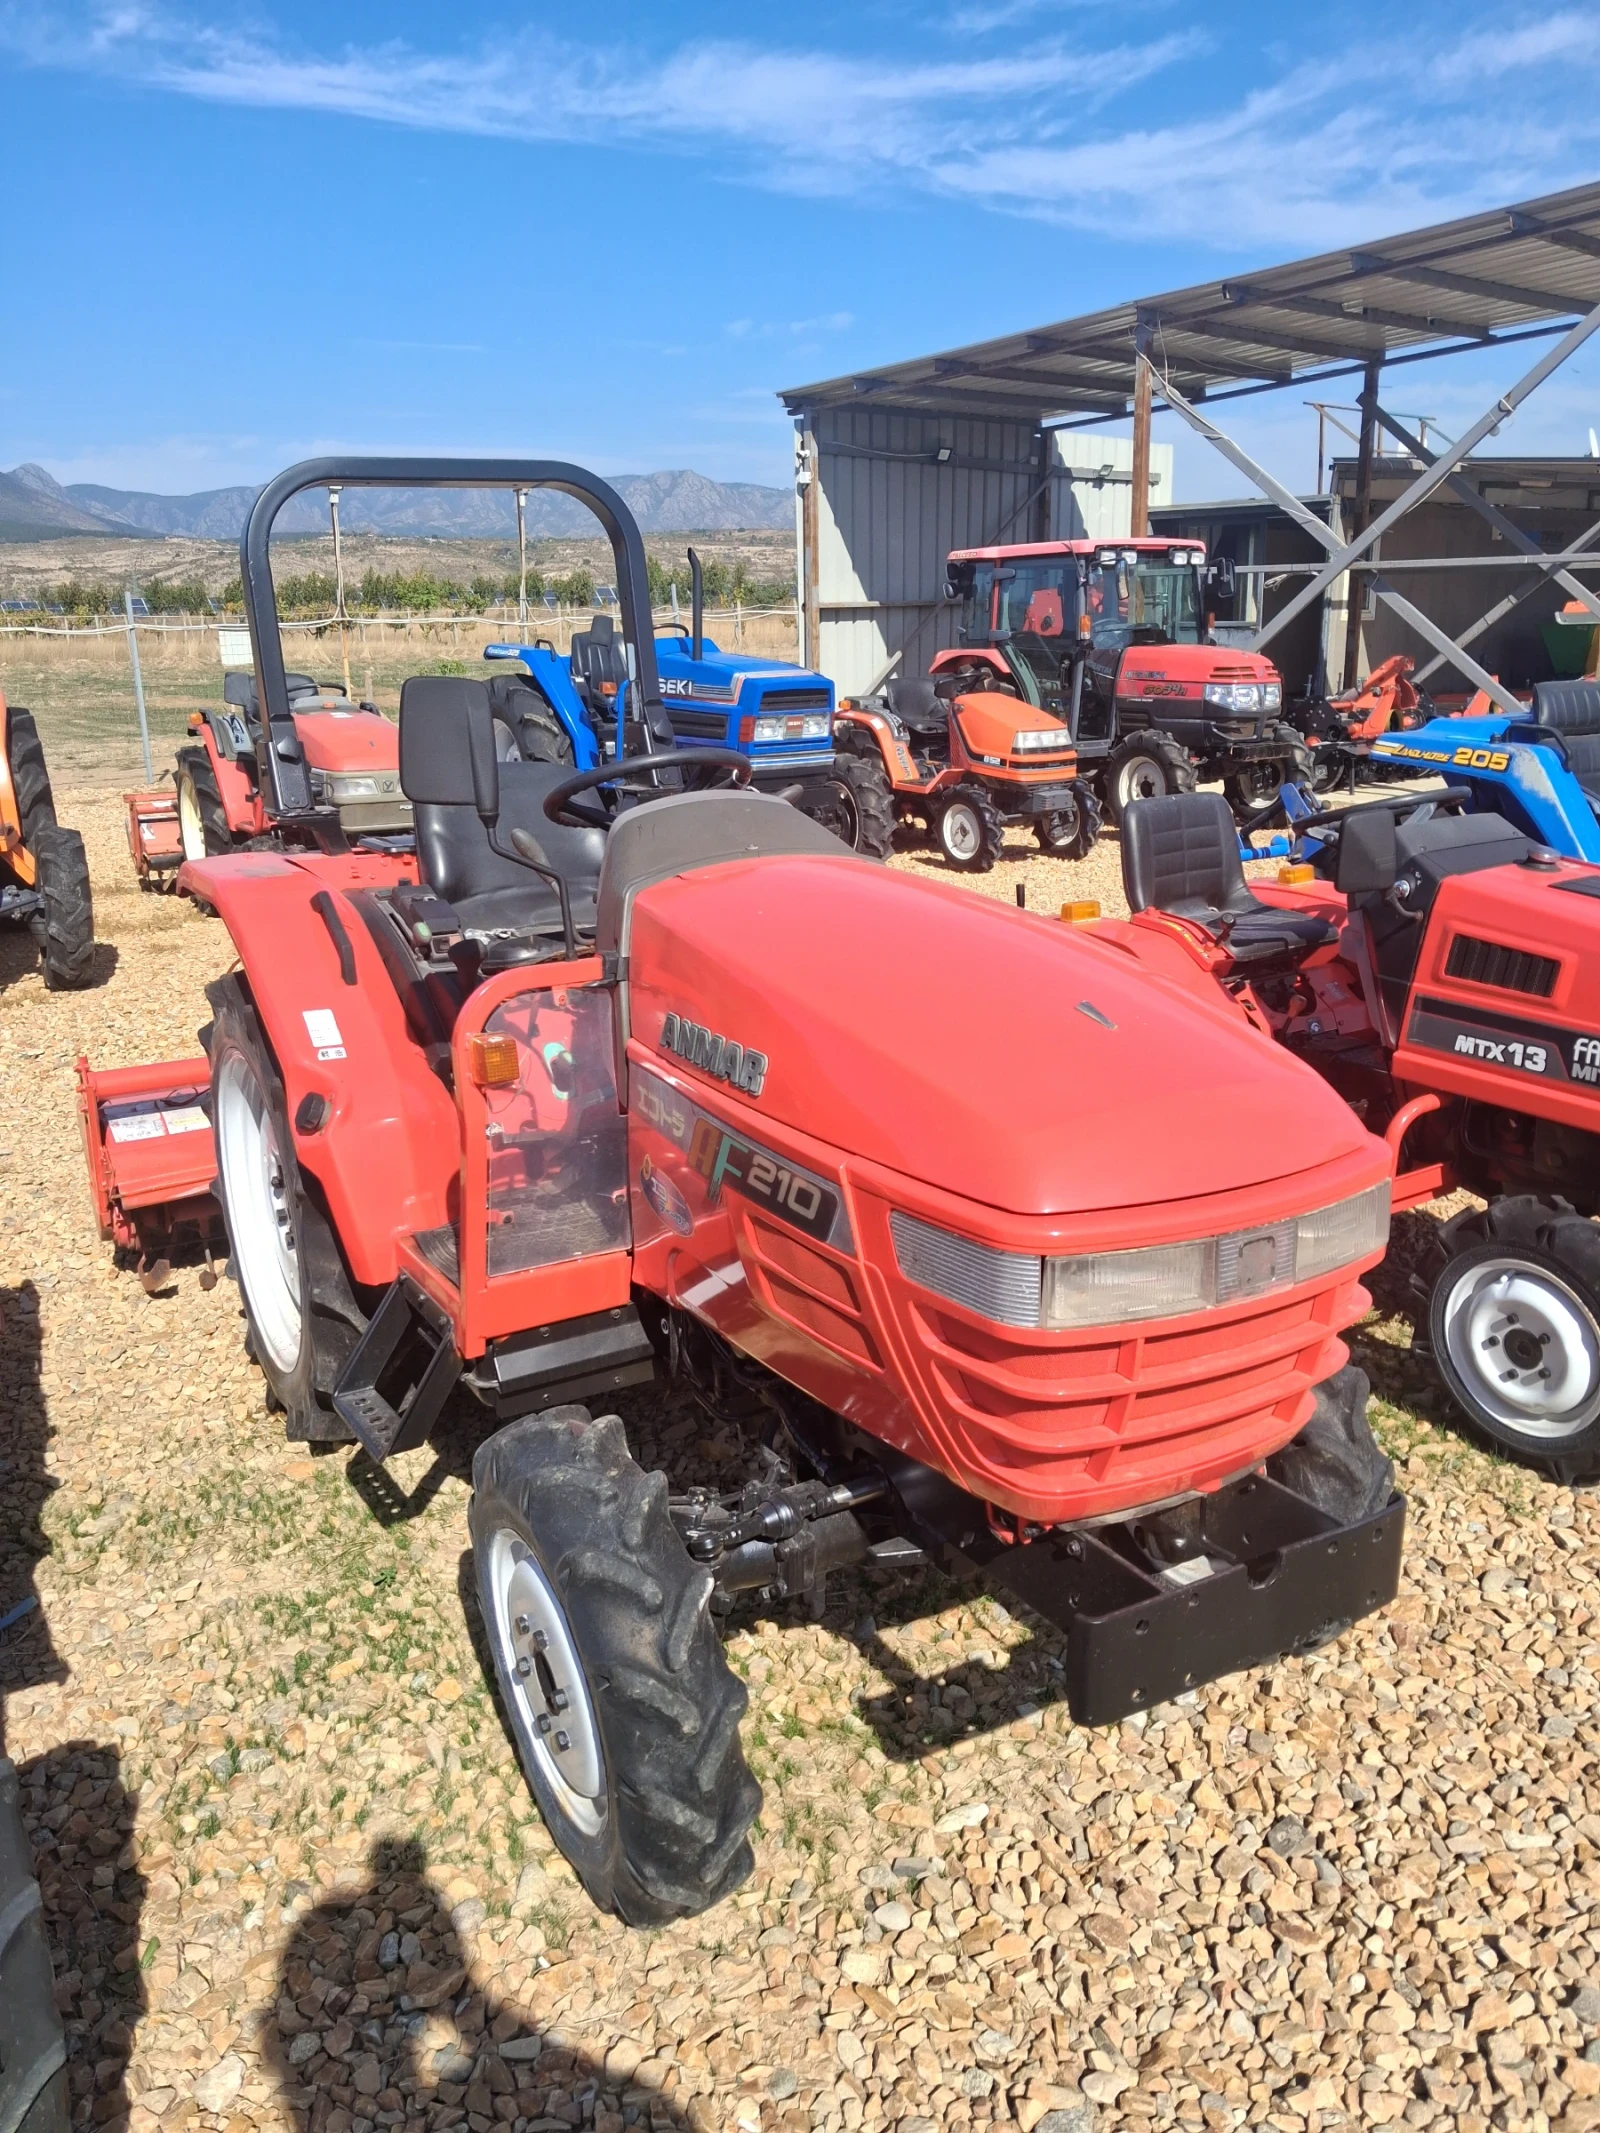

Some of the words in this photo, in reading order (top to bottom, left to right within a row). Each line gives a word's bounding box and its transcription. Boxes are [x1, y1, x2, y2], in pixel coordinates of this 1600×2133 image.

[658, 678, 693, 695] SEKI
[1452, 747, 1510, 771] 205
[660, 1011, 768, 1097] ANMAR
[1571, 1063, 1600, 1083] MI
